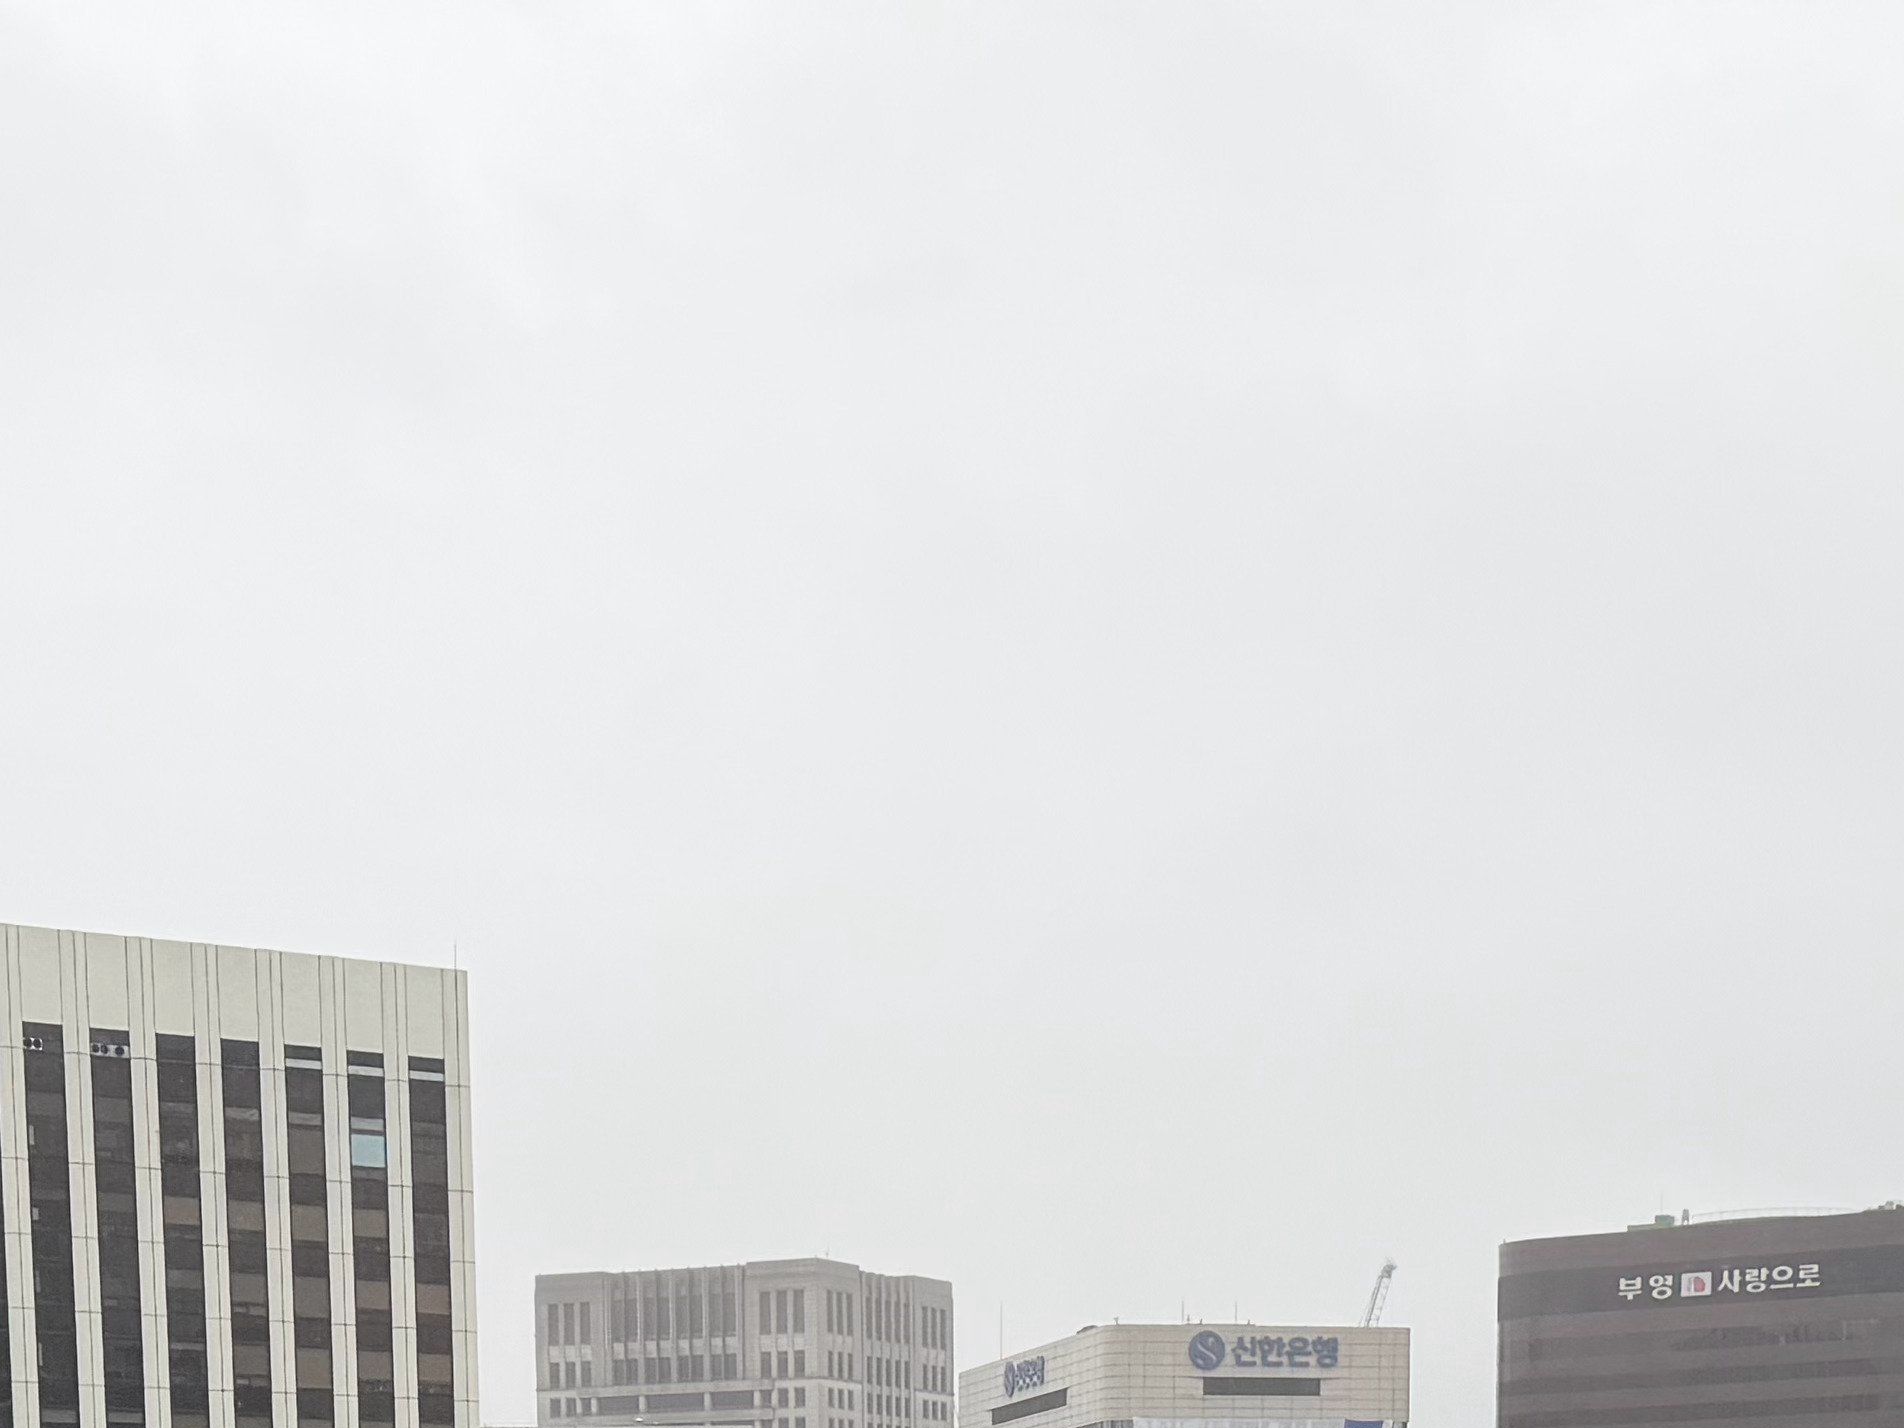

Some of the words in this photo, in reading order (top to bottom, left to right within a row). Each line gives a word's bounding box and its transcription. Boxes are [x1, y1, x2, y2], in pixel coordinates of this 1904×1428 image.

[1618, 1274, 1673, 1300] 부영
[1717, 1264, 1822, 1294] 사랑으로
[1231, 1335, 1340, 1368] 신한은행
